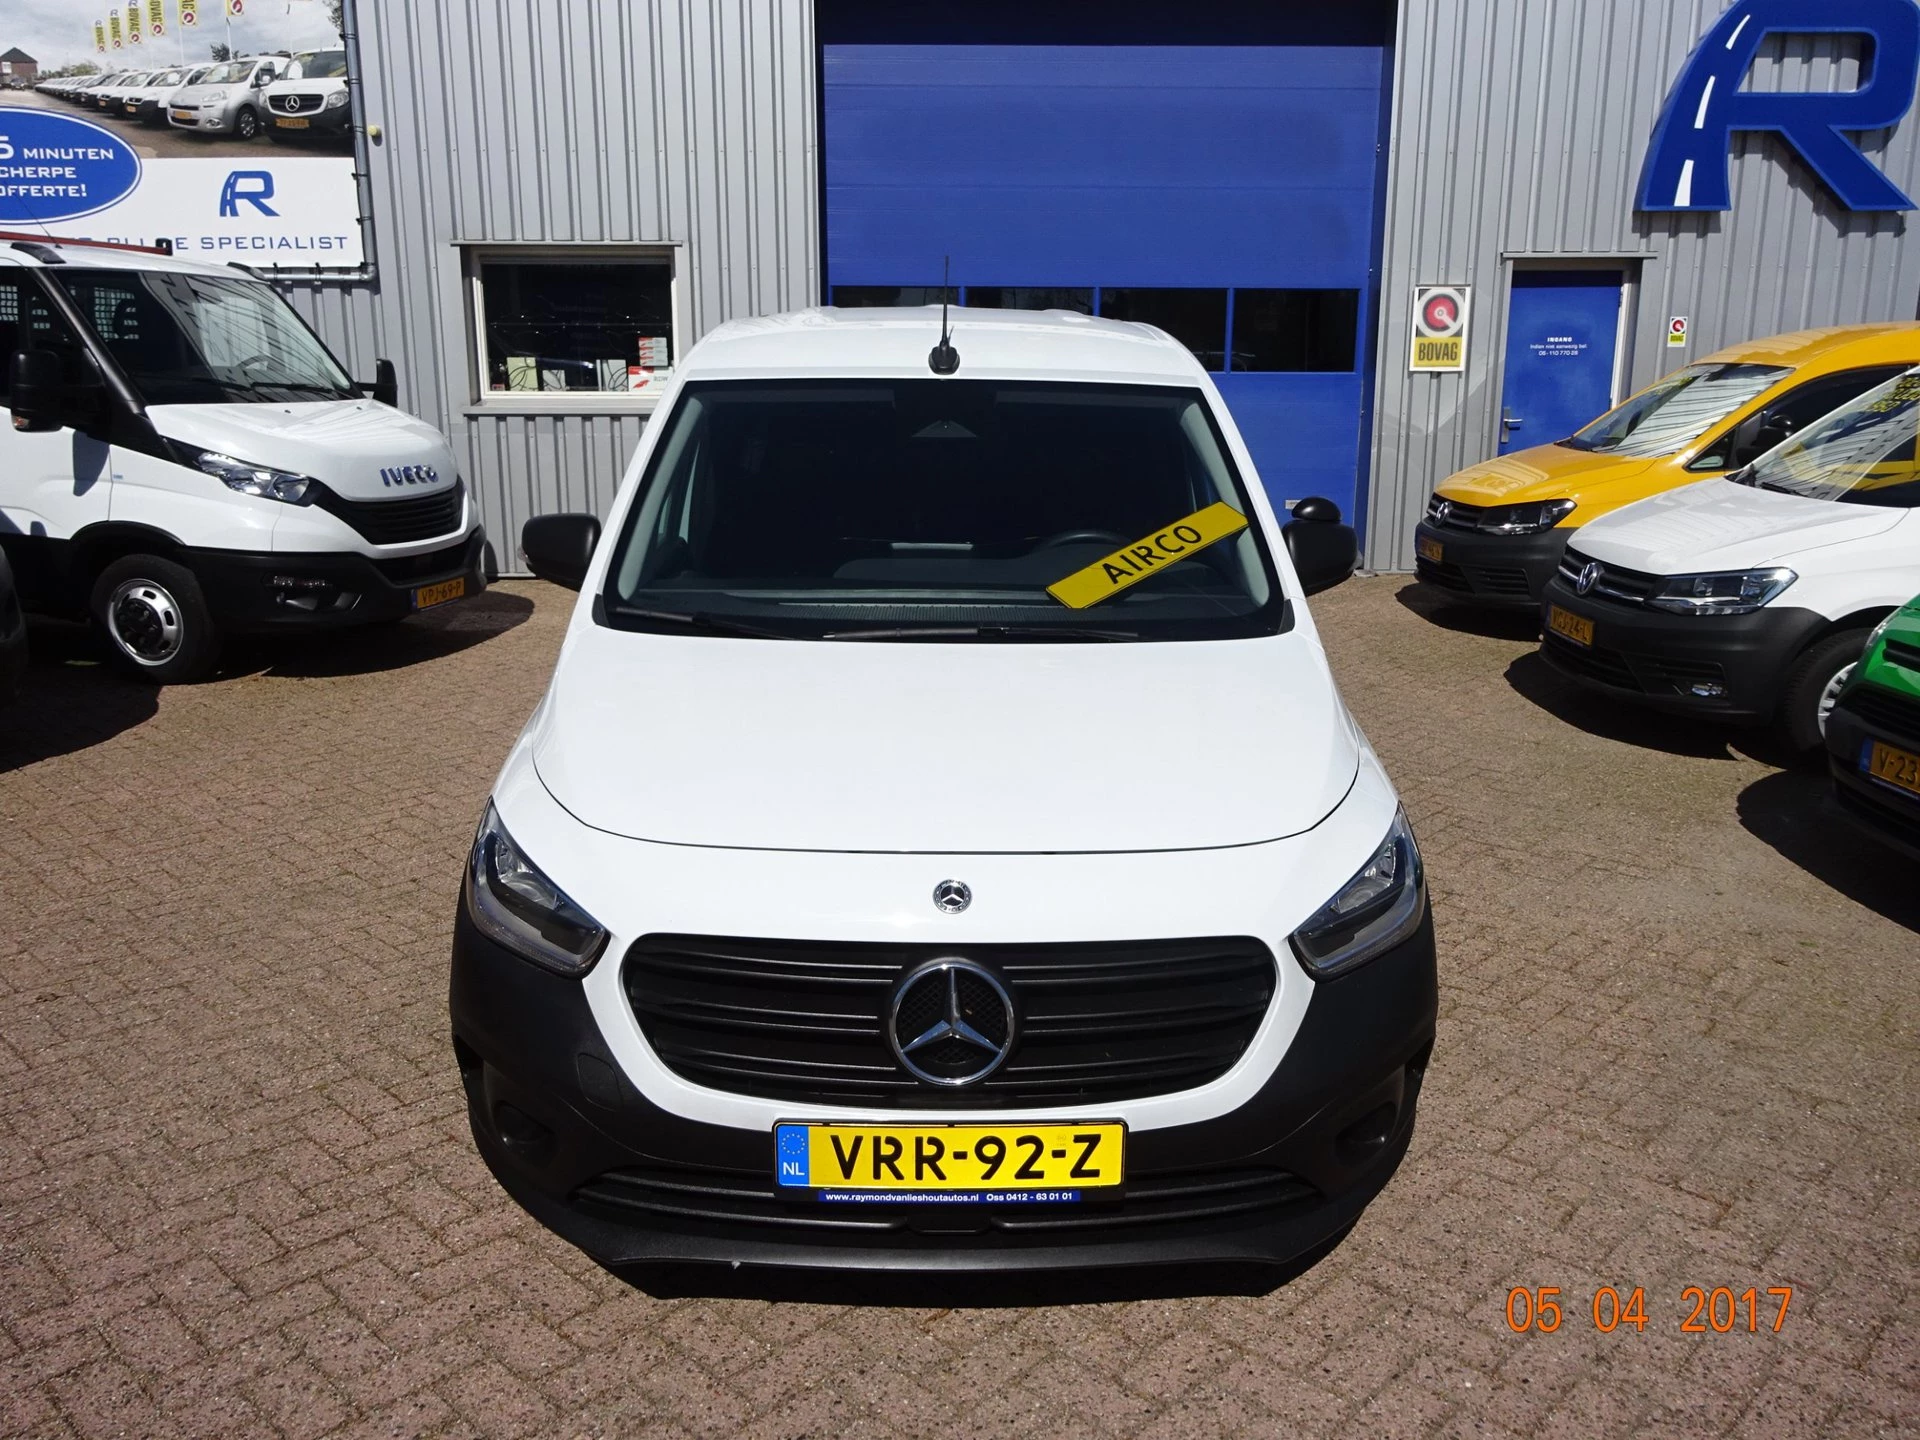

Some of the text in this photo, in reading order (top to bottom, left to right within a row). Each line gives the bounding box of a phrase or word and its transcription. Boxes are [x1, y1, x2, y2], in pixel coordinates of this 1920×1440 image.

[23, 148, 114, 160] MINUTEN
[200, 236, 348, 250] SPECIALIST
[1418, 342, 1459, 361] BOVAG
[379, 464, 439, 487] IVECO
[1101, 525, 1203, 585] AIRCO
[829, 1134, 1102, 1181] VRR-92-Z
[782, 1161, 805, 1176] NL
[825, 1193, 979, 1202] www.raymondvanlieshoutautos.nl
[986, 1193, 1005, 1201] Oss
[1006, 1193, 1028, 1201] 0412
[1036, 1193, 1048, 1201] 63
[1049, 1193, 1061, 1201] 01
[1062, 1193, 1073, 1201] 01
